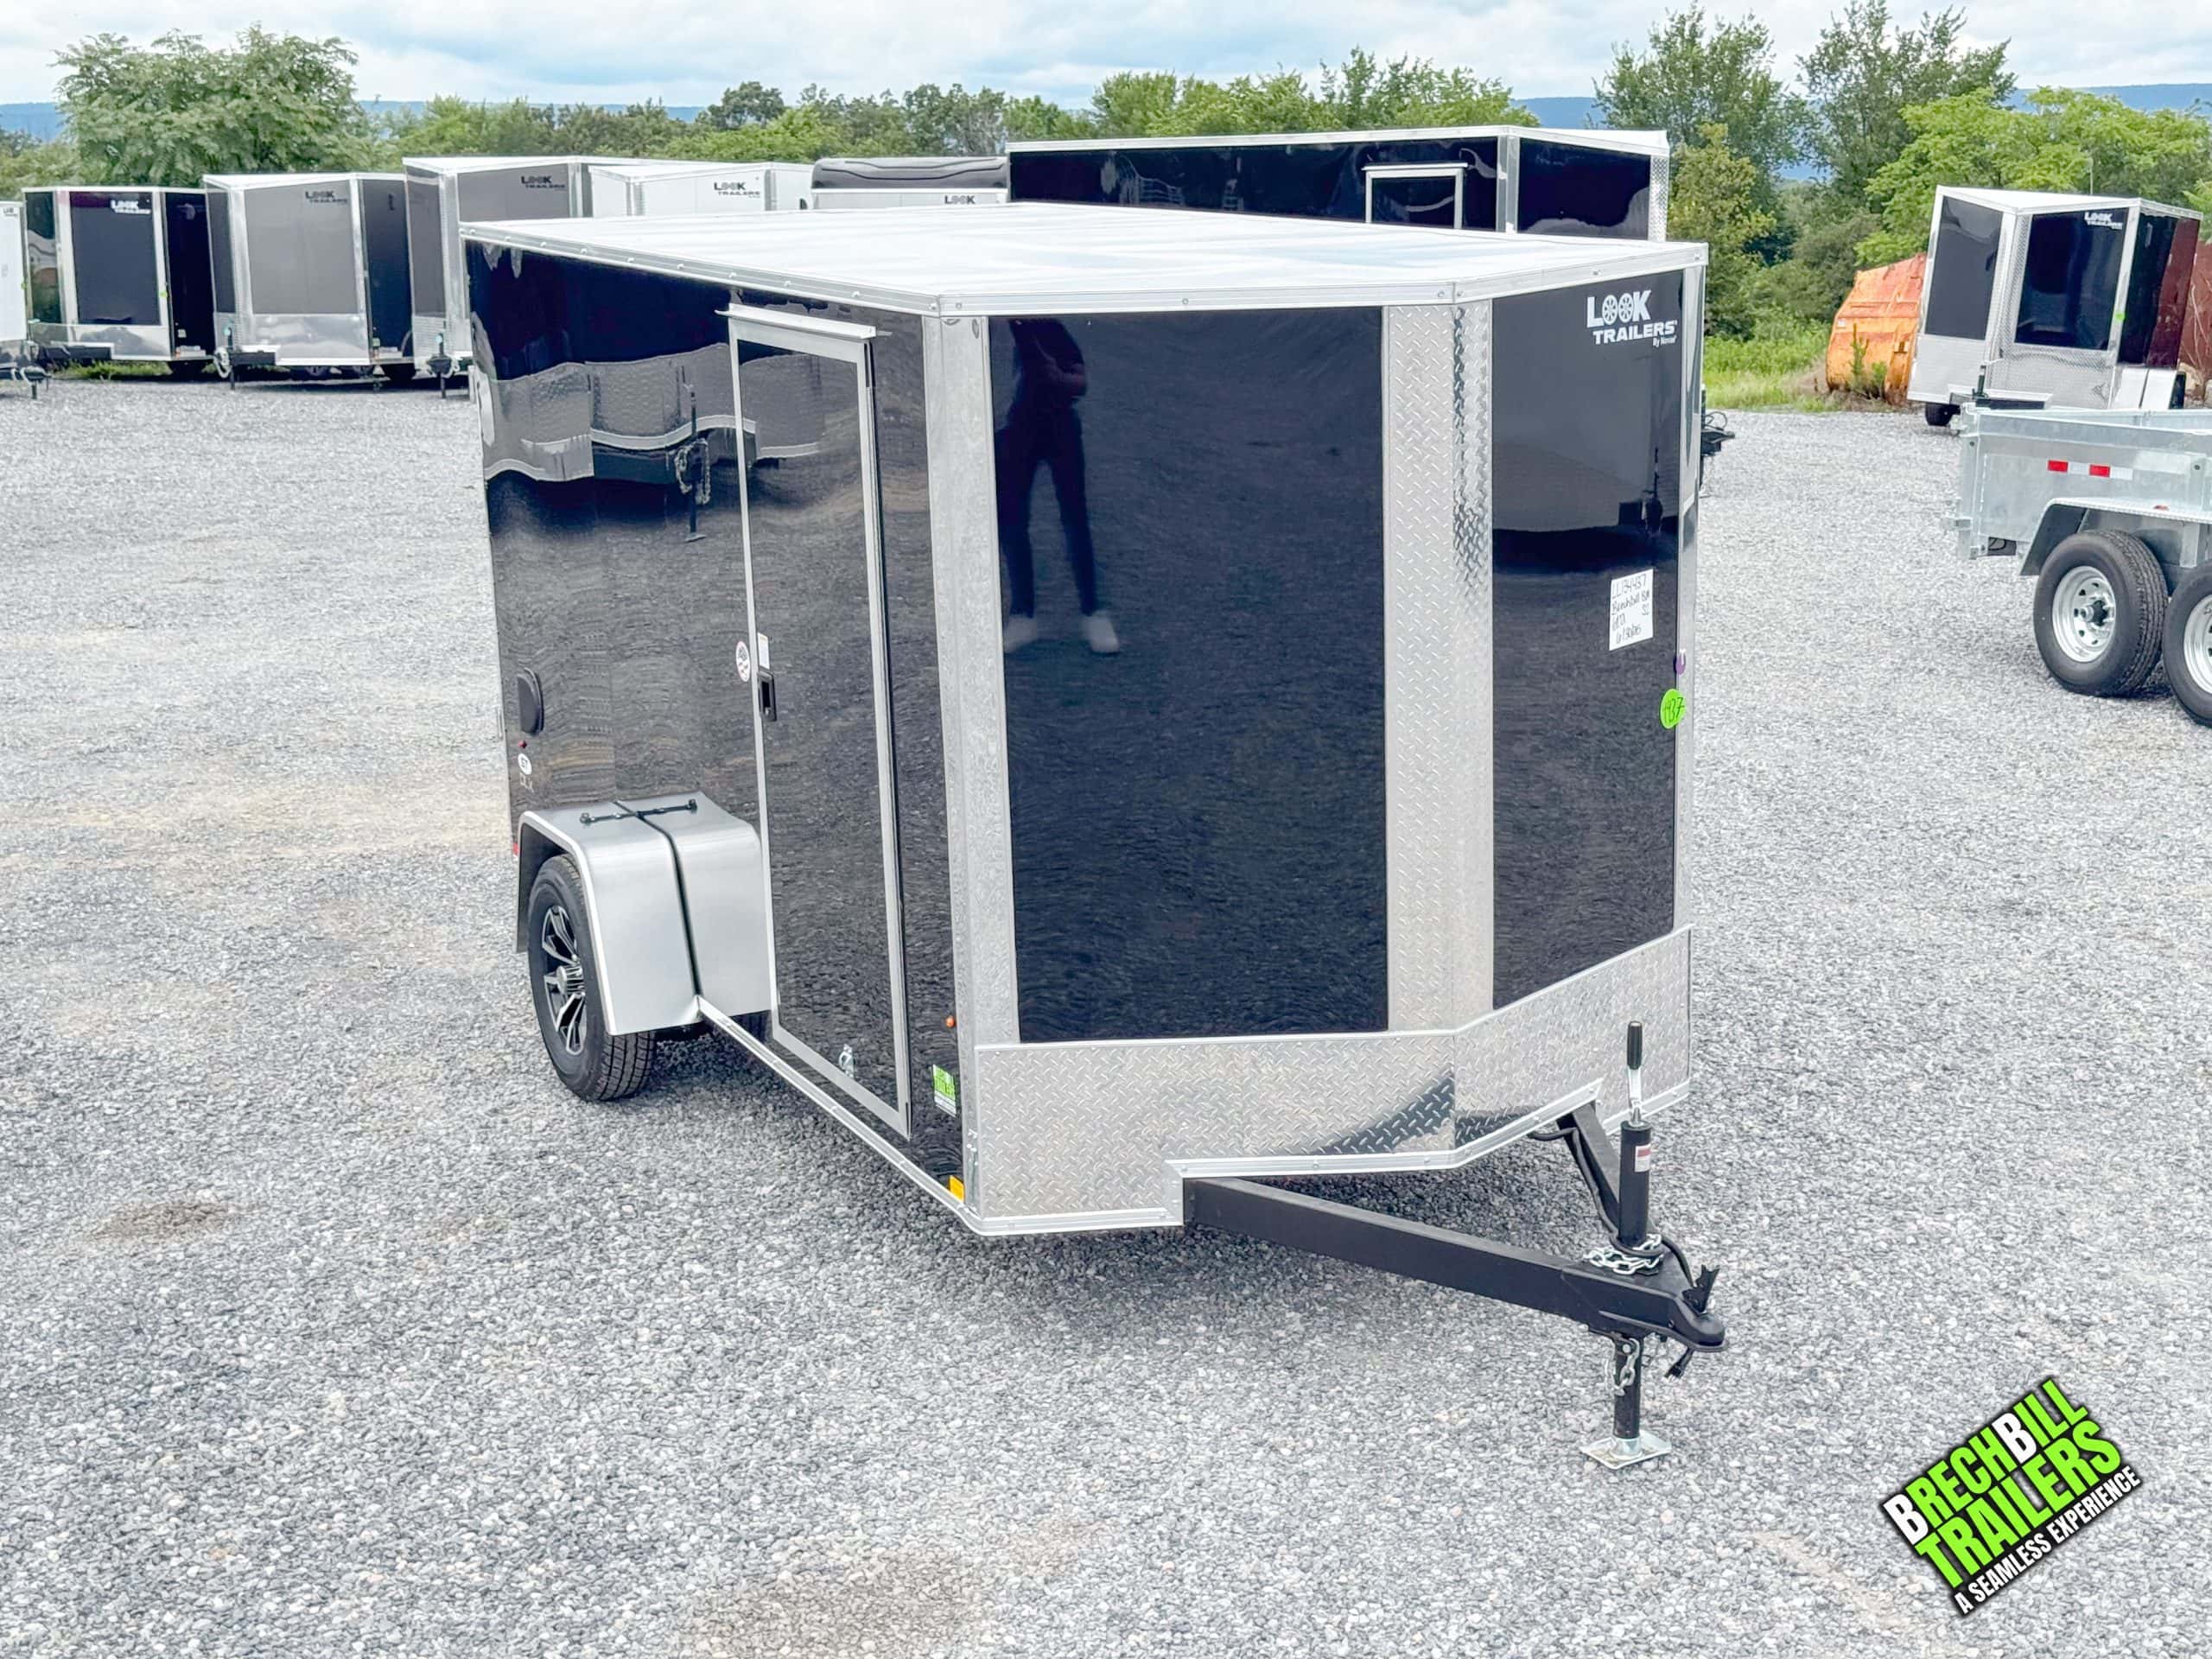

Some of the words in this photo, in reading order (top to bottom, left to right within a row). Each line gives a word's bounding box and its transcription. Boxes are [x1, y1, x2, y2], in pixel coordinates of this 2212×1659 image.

[521, 175, 551, 184] LOOK
[714, 181, 746, 190] LOOK
[305, 190, 334, 199] LOOK
[944, 194, 976, 205] LOOK
[110, 200, 139, 209] LOOK
[2084, 212, 2113, 221] LOOK
[1586, 289, 1652, 328] LOOK
[1592, 320, 1677, 345] TRAILERS
